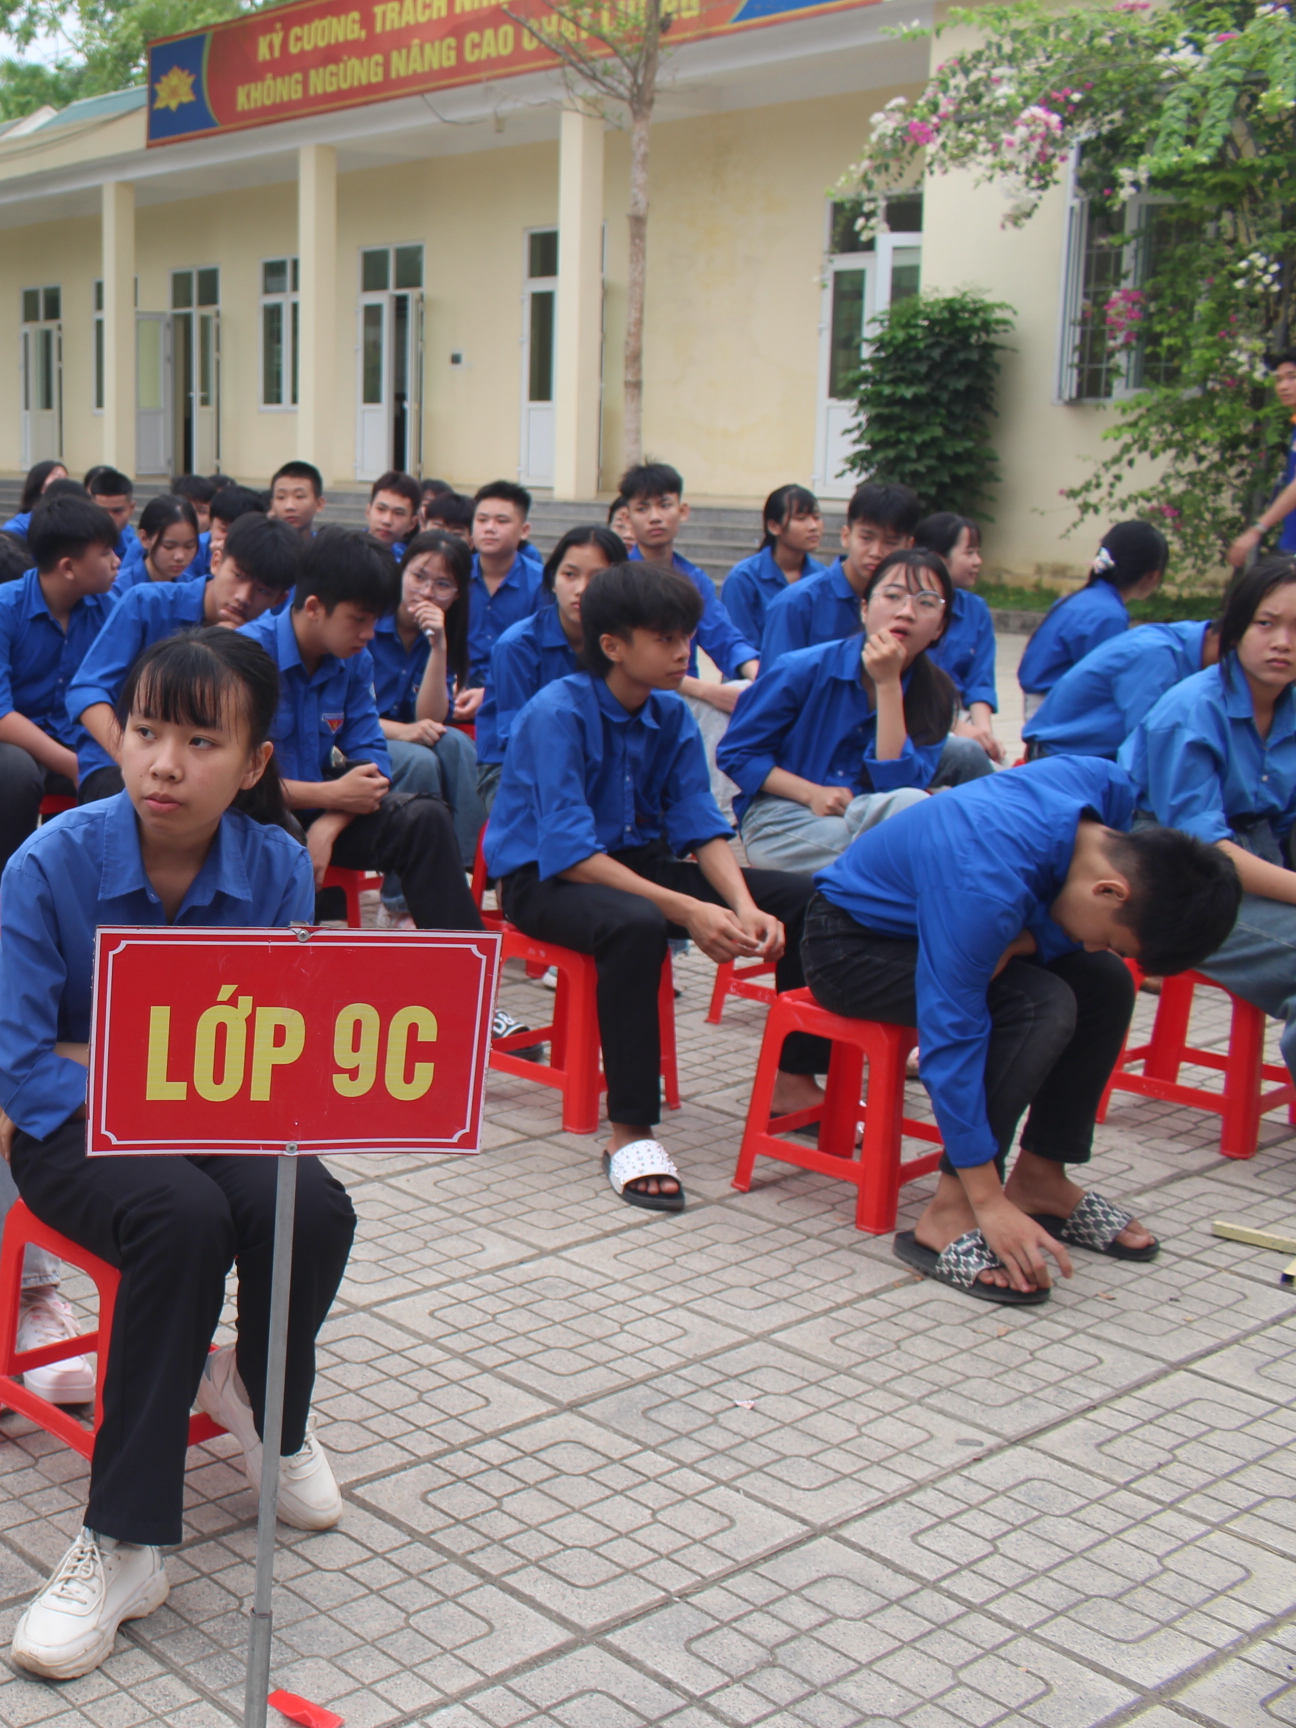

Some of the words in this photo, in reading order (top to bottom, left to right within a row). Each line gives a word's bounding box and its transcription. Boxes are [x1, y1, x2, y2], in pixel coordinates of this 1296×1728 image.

[236, 72, 303, 112] KHÔNG
[309, 54, 384, 96] NGỪNG
[390, 36, 457, 79] NÂNG
[464, 24, 515, 62] CAO
[146, 985, 305, 1102] LỚP
[332, 1003, 438, 1101] 9C
